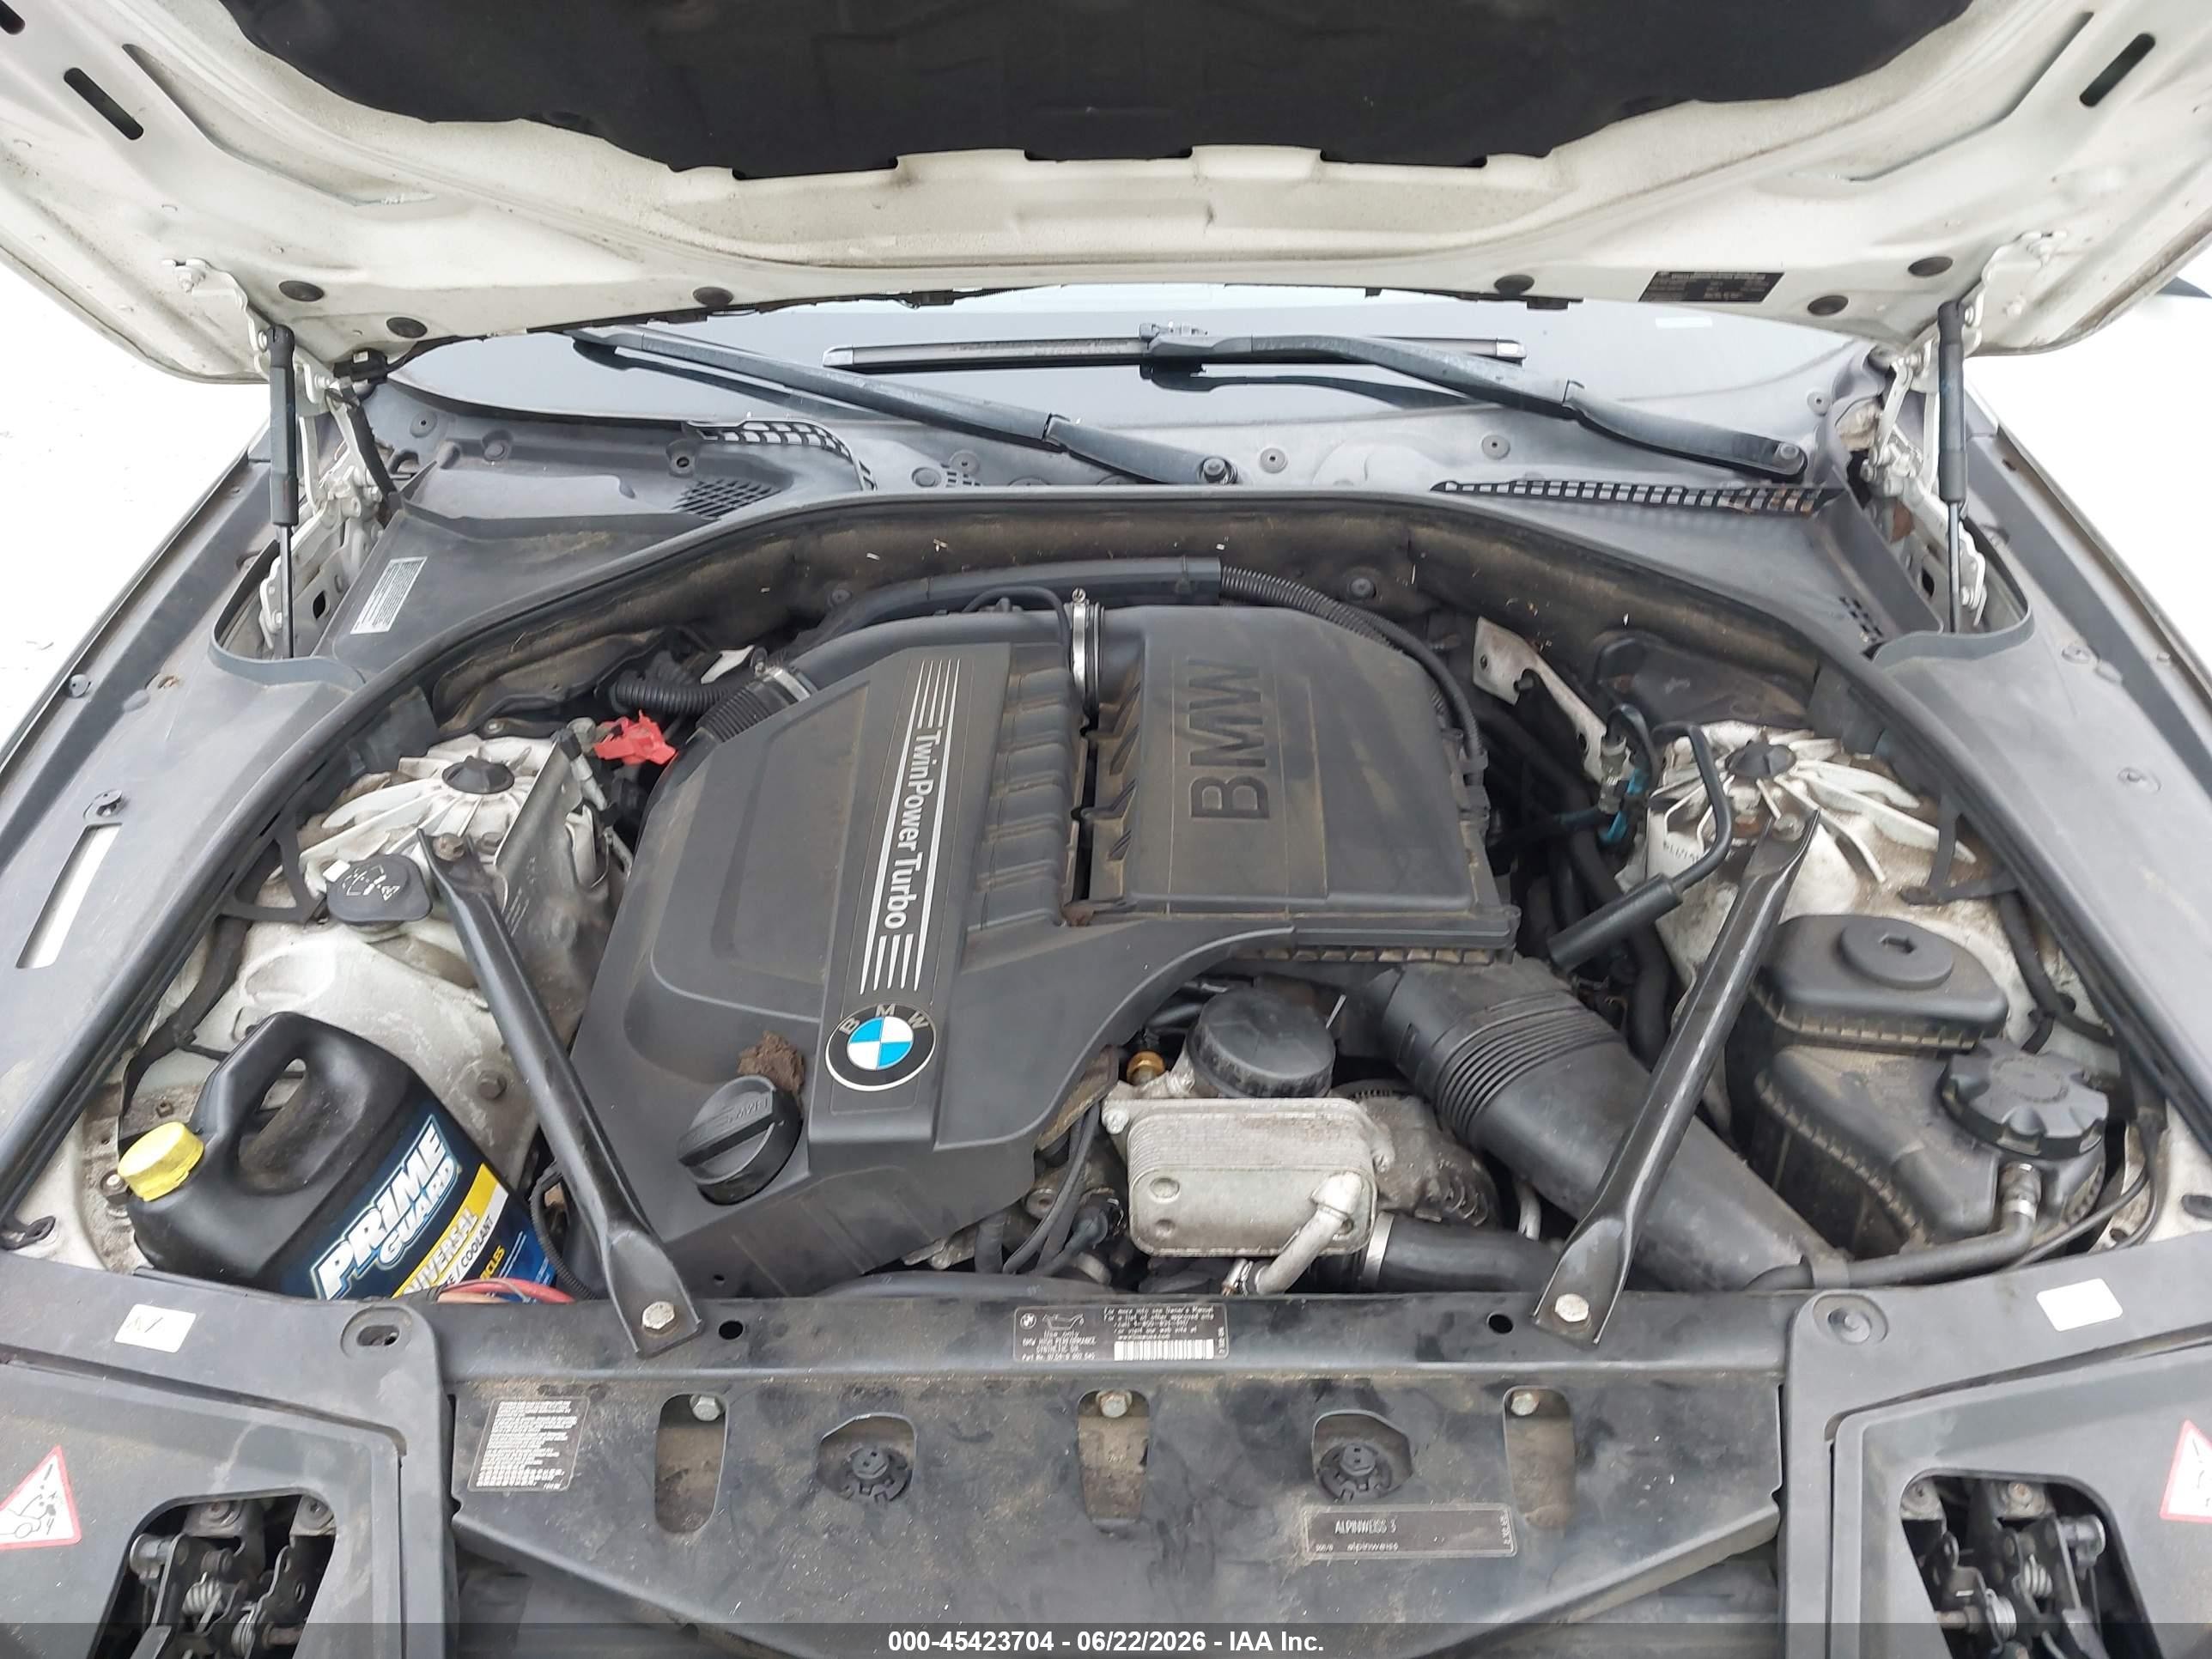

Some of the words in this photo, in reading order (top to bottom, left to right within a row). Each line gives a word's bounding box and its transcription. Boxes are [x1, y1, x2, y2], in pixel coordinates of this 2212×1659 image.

[1188, 659, 1269, 818] BMW
[884, 852, 923, 930] Turbo
[839, 1003, 929, 1036] BMW
[318, 1122, 447, 1300] PRIME
[379, 1156, 454, 1264] GUARD
[460, 1213, 494, 1268] COOLANT
[1334, 1518, 1388, 1535] ALPINWEISS
